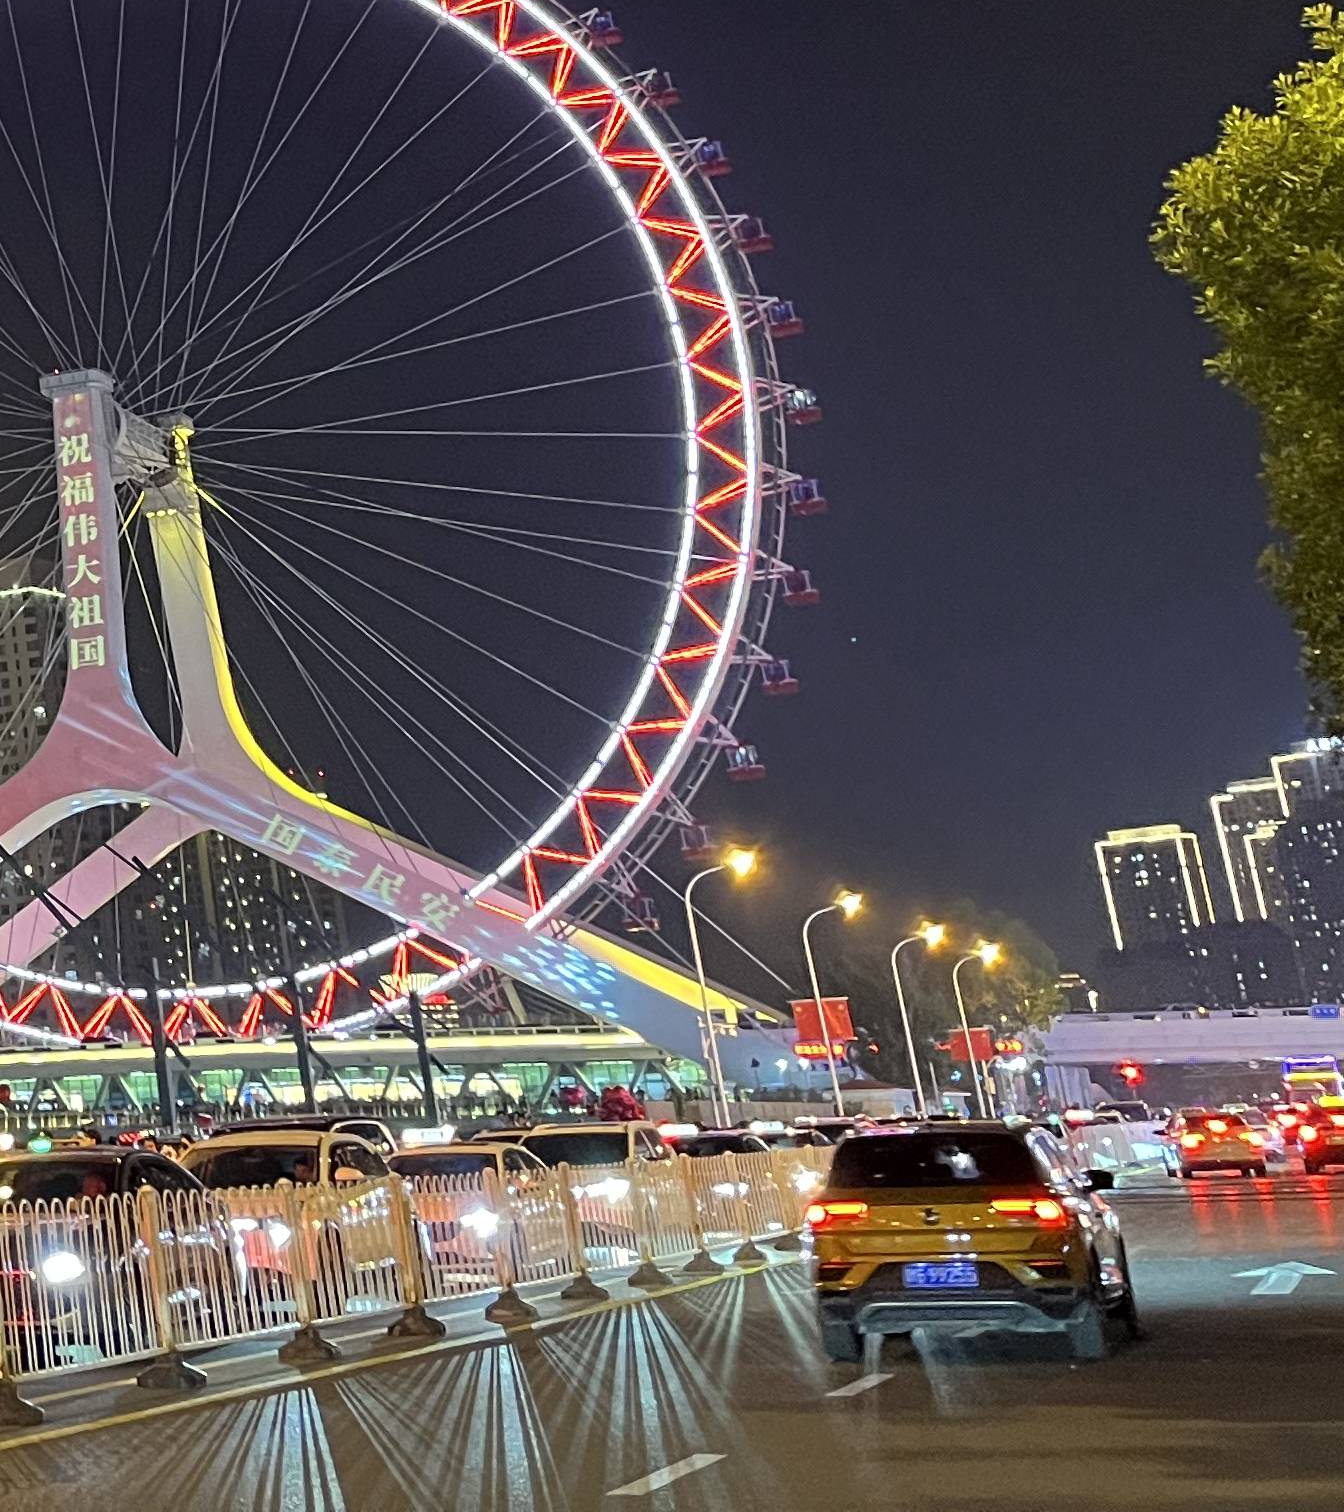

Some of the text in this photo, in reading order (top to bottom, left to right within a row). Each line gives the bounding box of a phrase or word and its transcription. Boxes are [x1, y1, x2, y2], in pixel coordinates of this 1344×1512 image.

[56, 432, 106, 671] 祝福伟大祖国
[263, 813, 460, 932] 国泰民安
